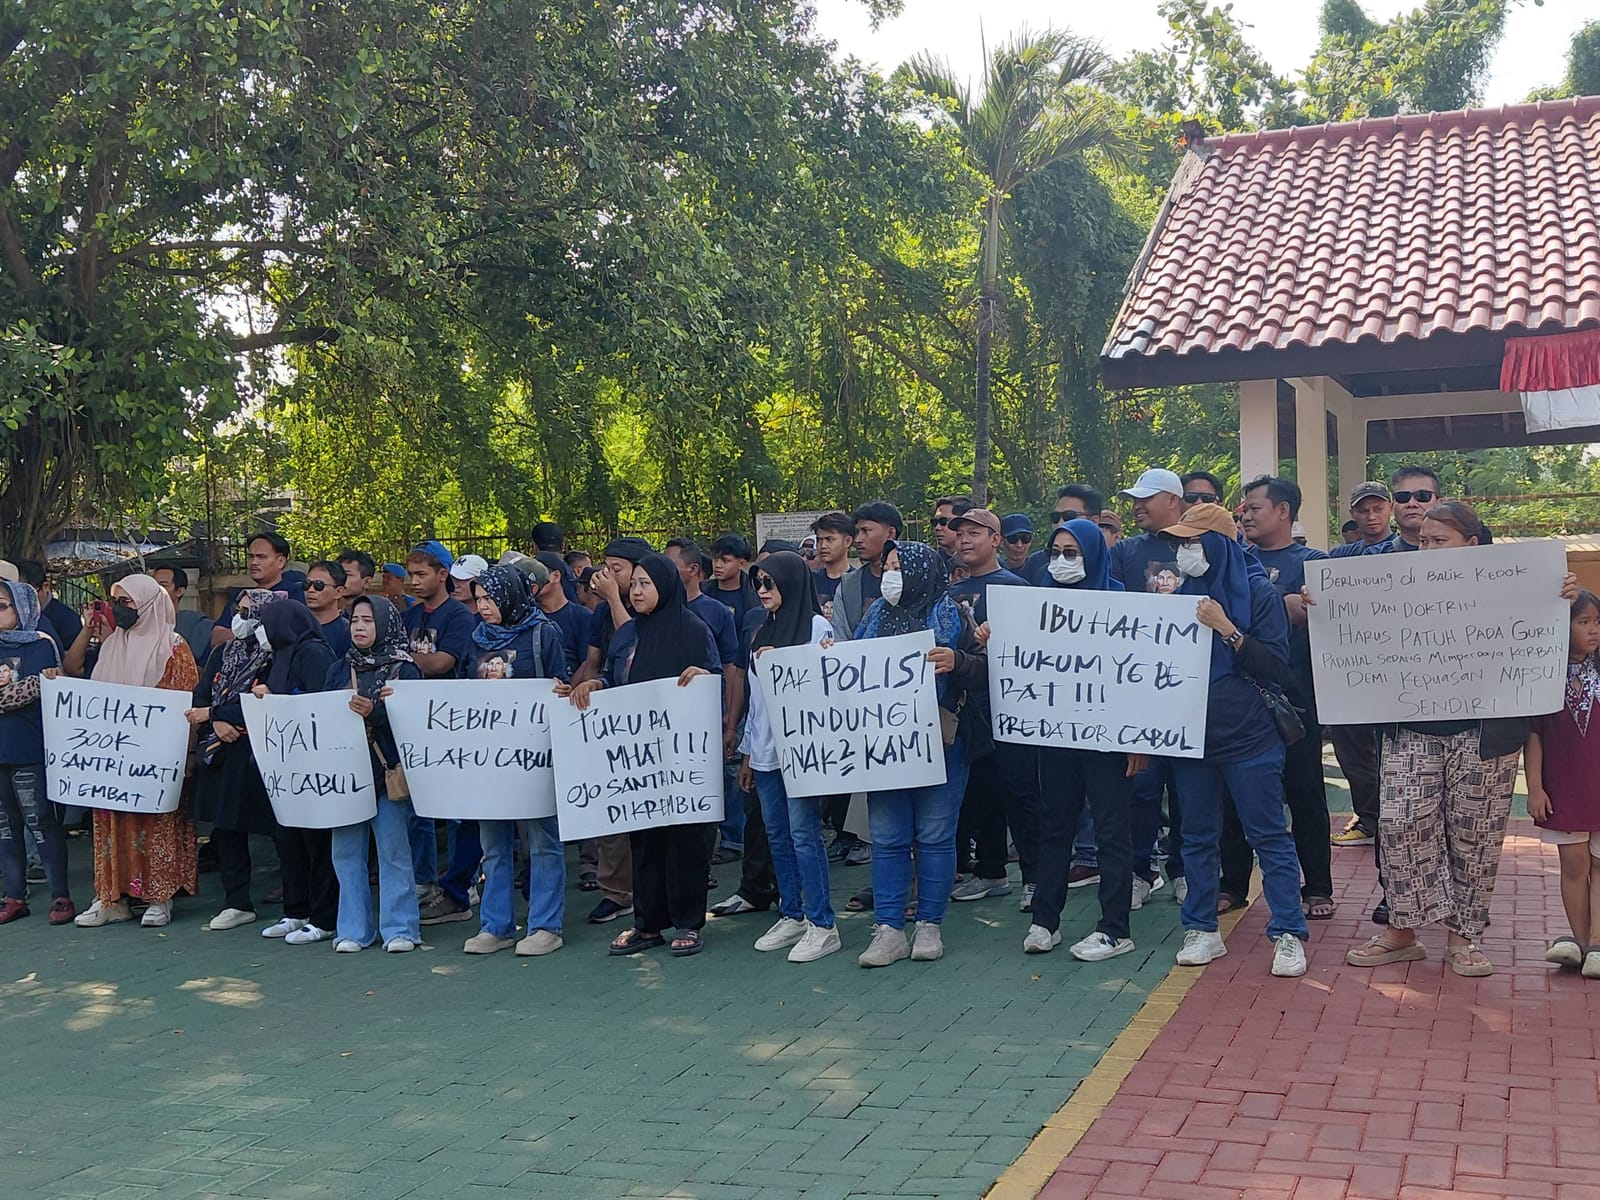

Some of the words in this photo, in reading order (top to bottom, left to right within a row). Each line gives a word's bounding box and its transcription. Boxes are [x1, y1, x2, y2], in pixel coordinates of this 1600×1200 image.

[1474, 564, 1528, 582] KEDOK
[1039, 601, 1083, 633] IBU
[1328, 598, 1359, 621] ILMU
[1370, 601, 1396, 616] DAN
[1403, 600, 1477, 618] DOKTRIN
[1339, 623, 1392, 646] HARUS
[1400, 627, 1457, 649] PATUH
[1465, 624, 1504, 645] PADA
[997, 643, 1101, 674] HUKUM
[1321, 651, 1372, 670] PADAHAL
[1509, 642, 1563, 660] KORBAN
[769, 662, 811, 696] PAK
[1000, 678, 1064, 707] RAT
[1346, 670, 1388, 688] DEMI
[55, 691, 166, 729] MICHAT
[568, 708, 642, 743] TUKU
[995, 713, 1112, 743] PREDATOR
[1117, 724, 1200, 751] CABUL
[67, 728, 141, 752] 300K
[400, 743, 490, 770] PELAKU
[495, 747, 553, 771] CABUL
[78, 783, 146, 807] EMBAT
[291, 772, 373, 796] CABUL
[567, 782, 601, 808] OJO
